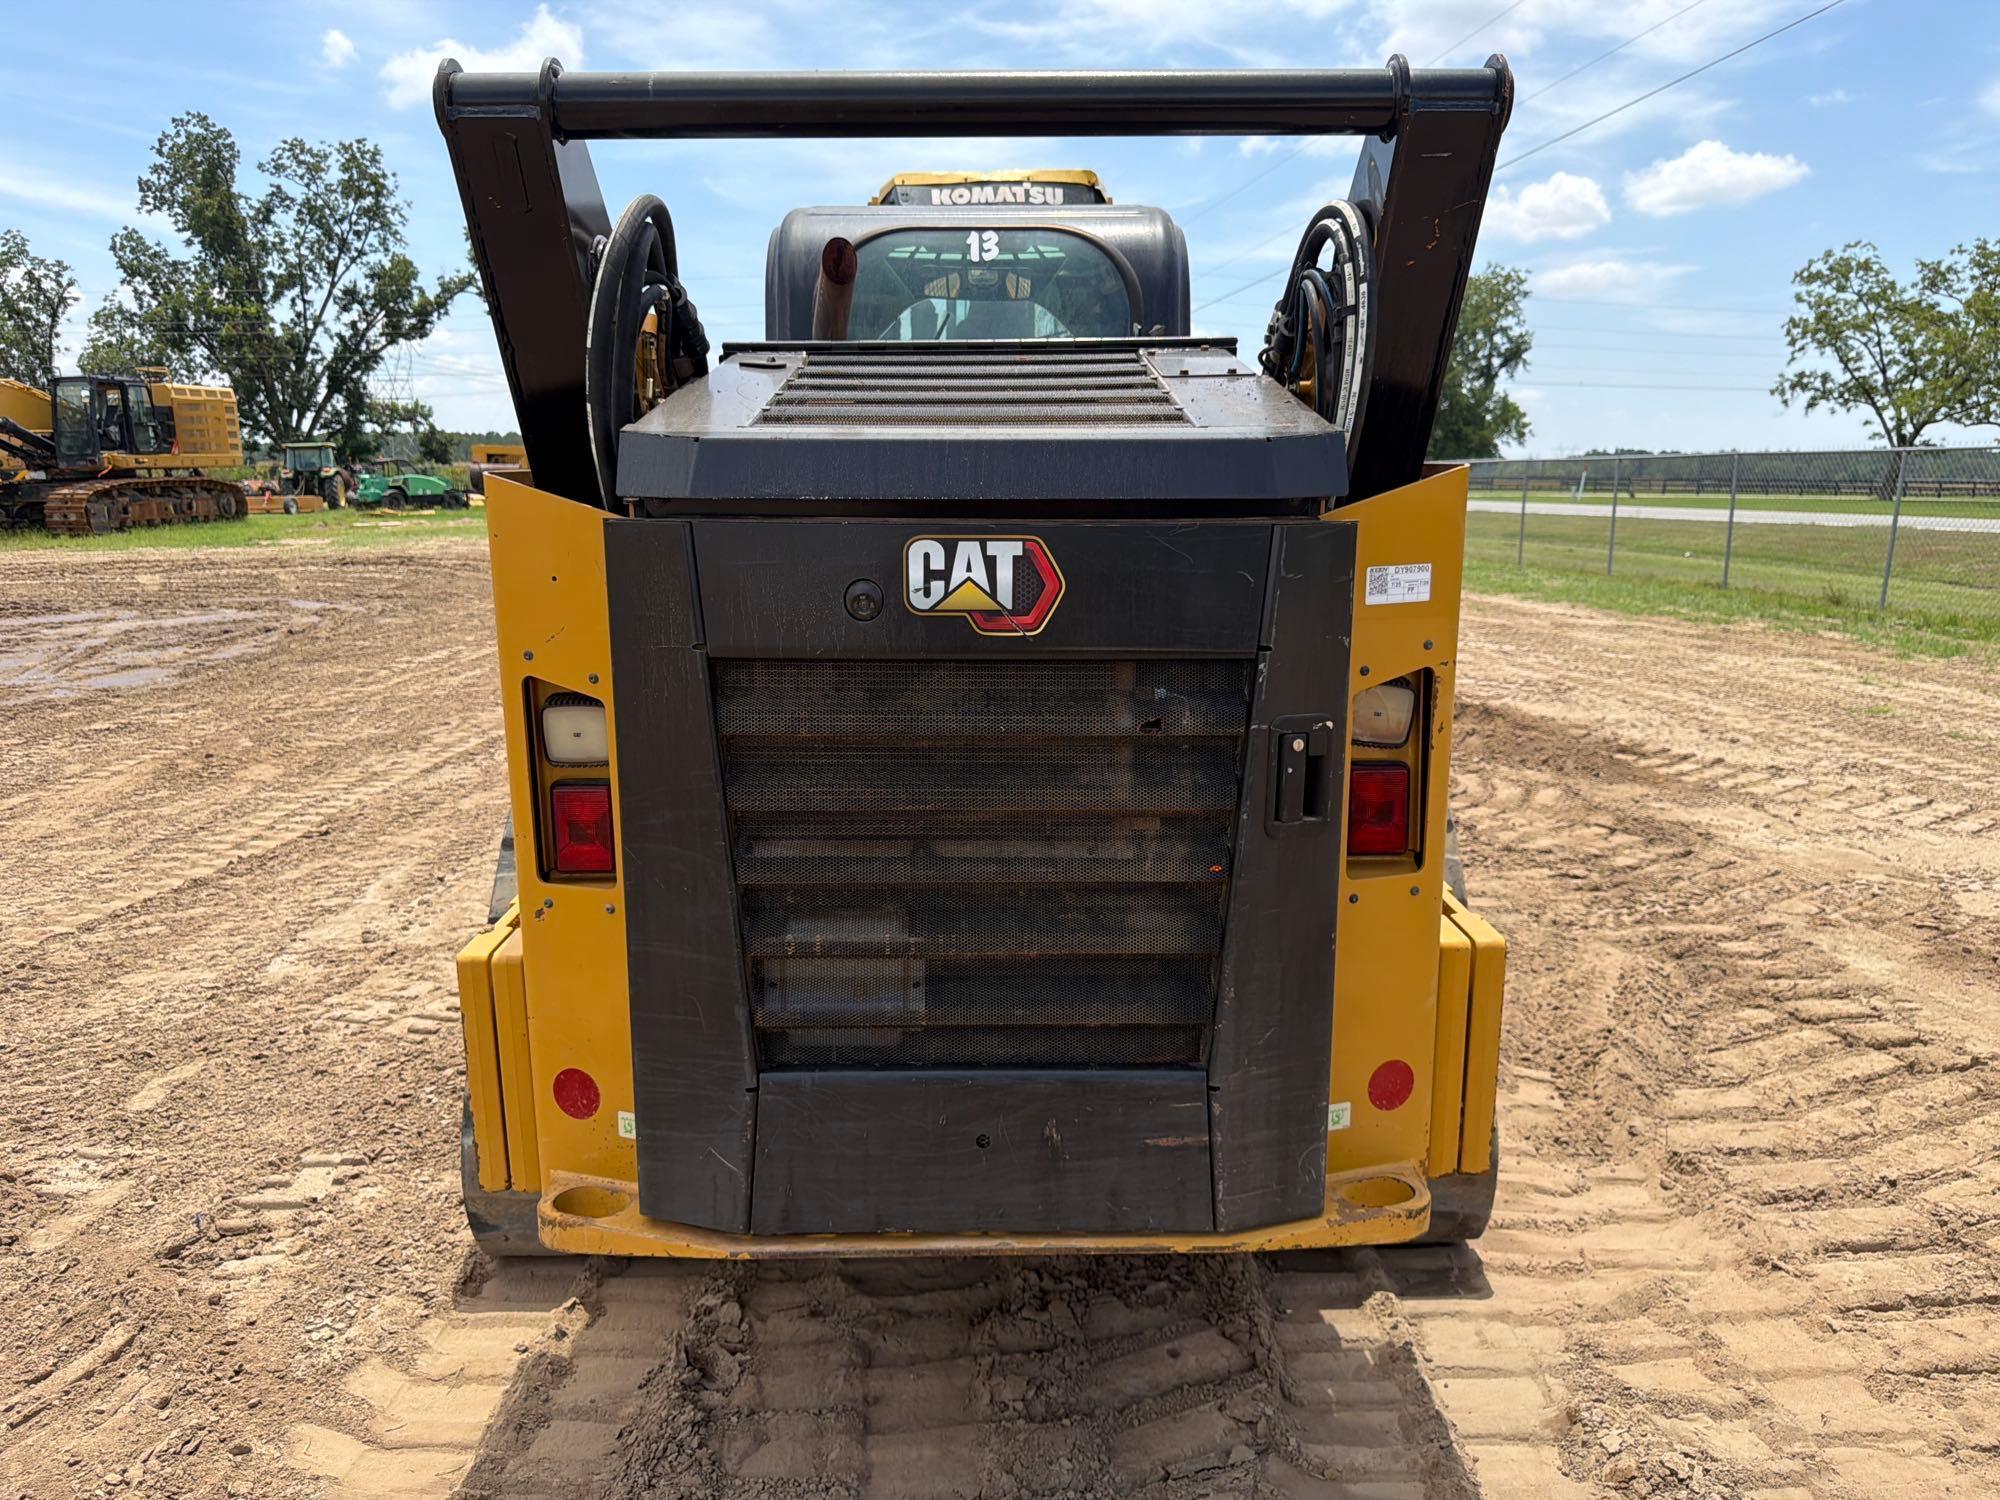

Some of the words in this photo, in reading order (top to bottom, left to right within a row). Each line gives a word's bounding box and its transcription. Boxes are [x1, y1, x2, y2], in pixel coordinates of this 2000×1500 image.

[931, 186, 1063, 205] KOMATSU
[966, 230, 999, 262] 13
[908, 539, 1023, 610] CAT
